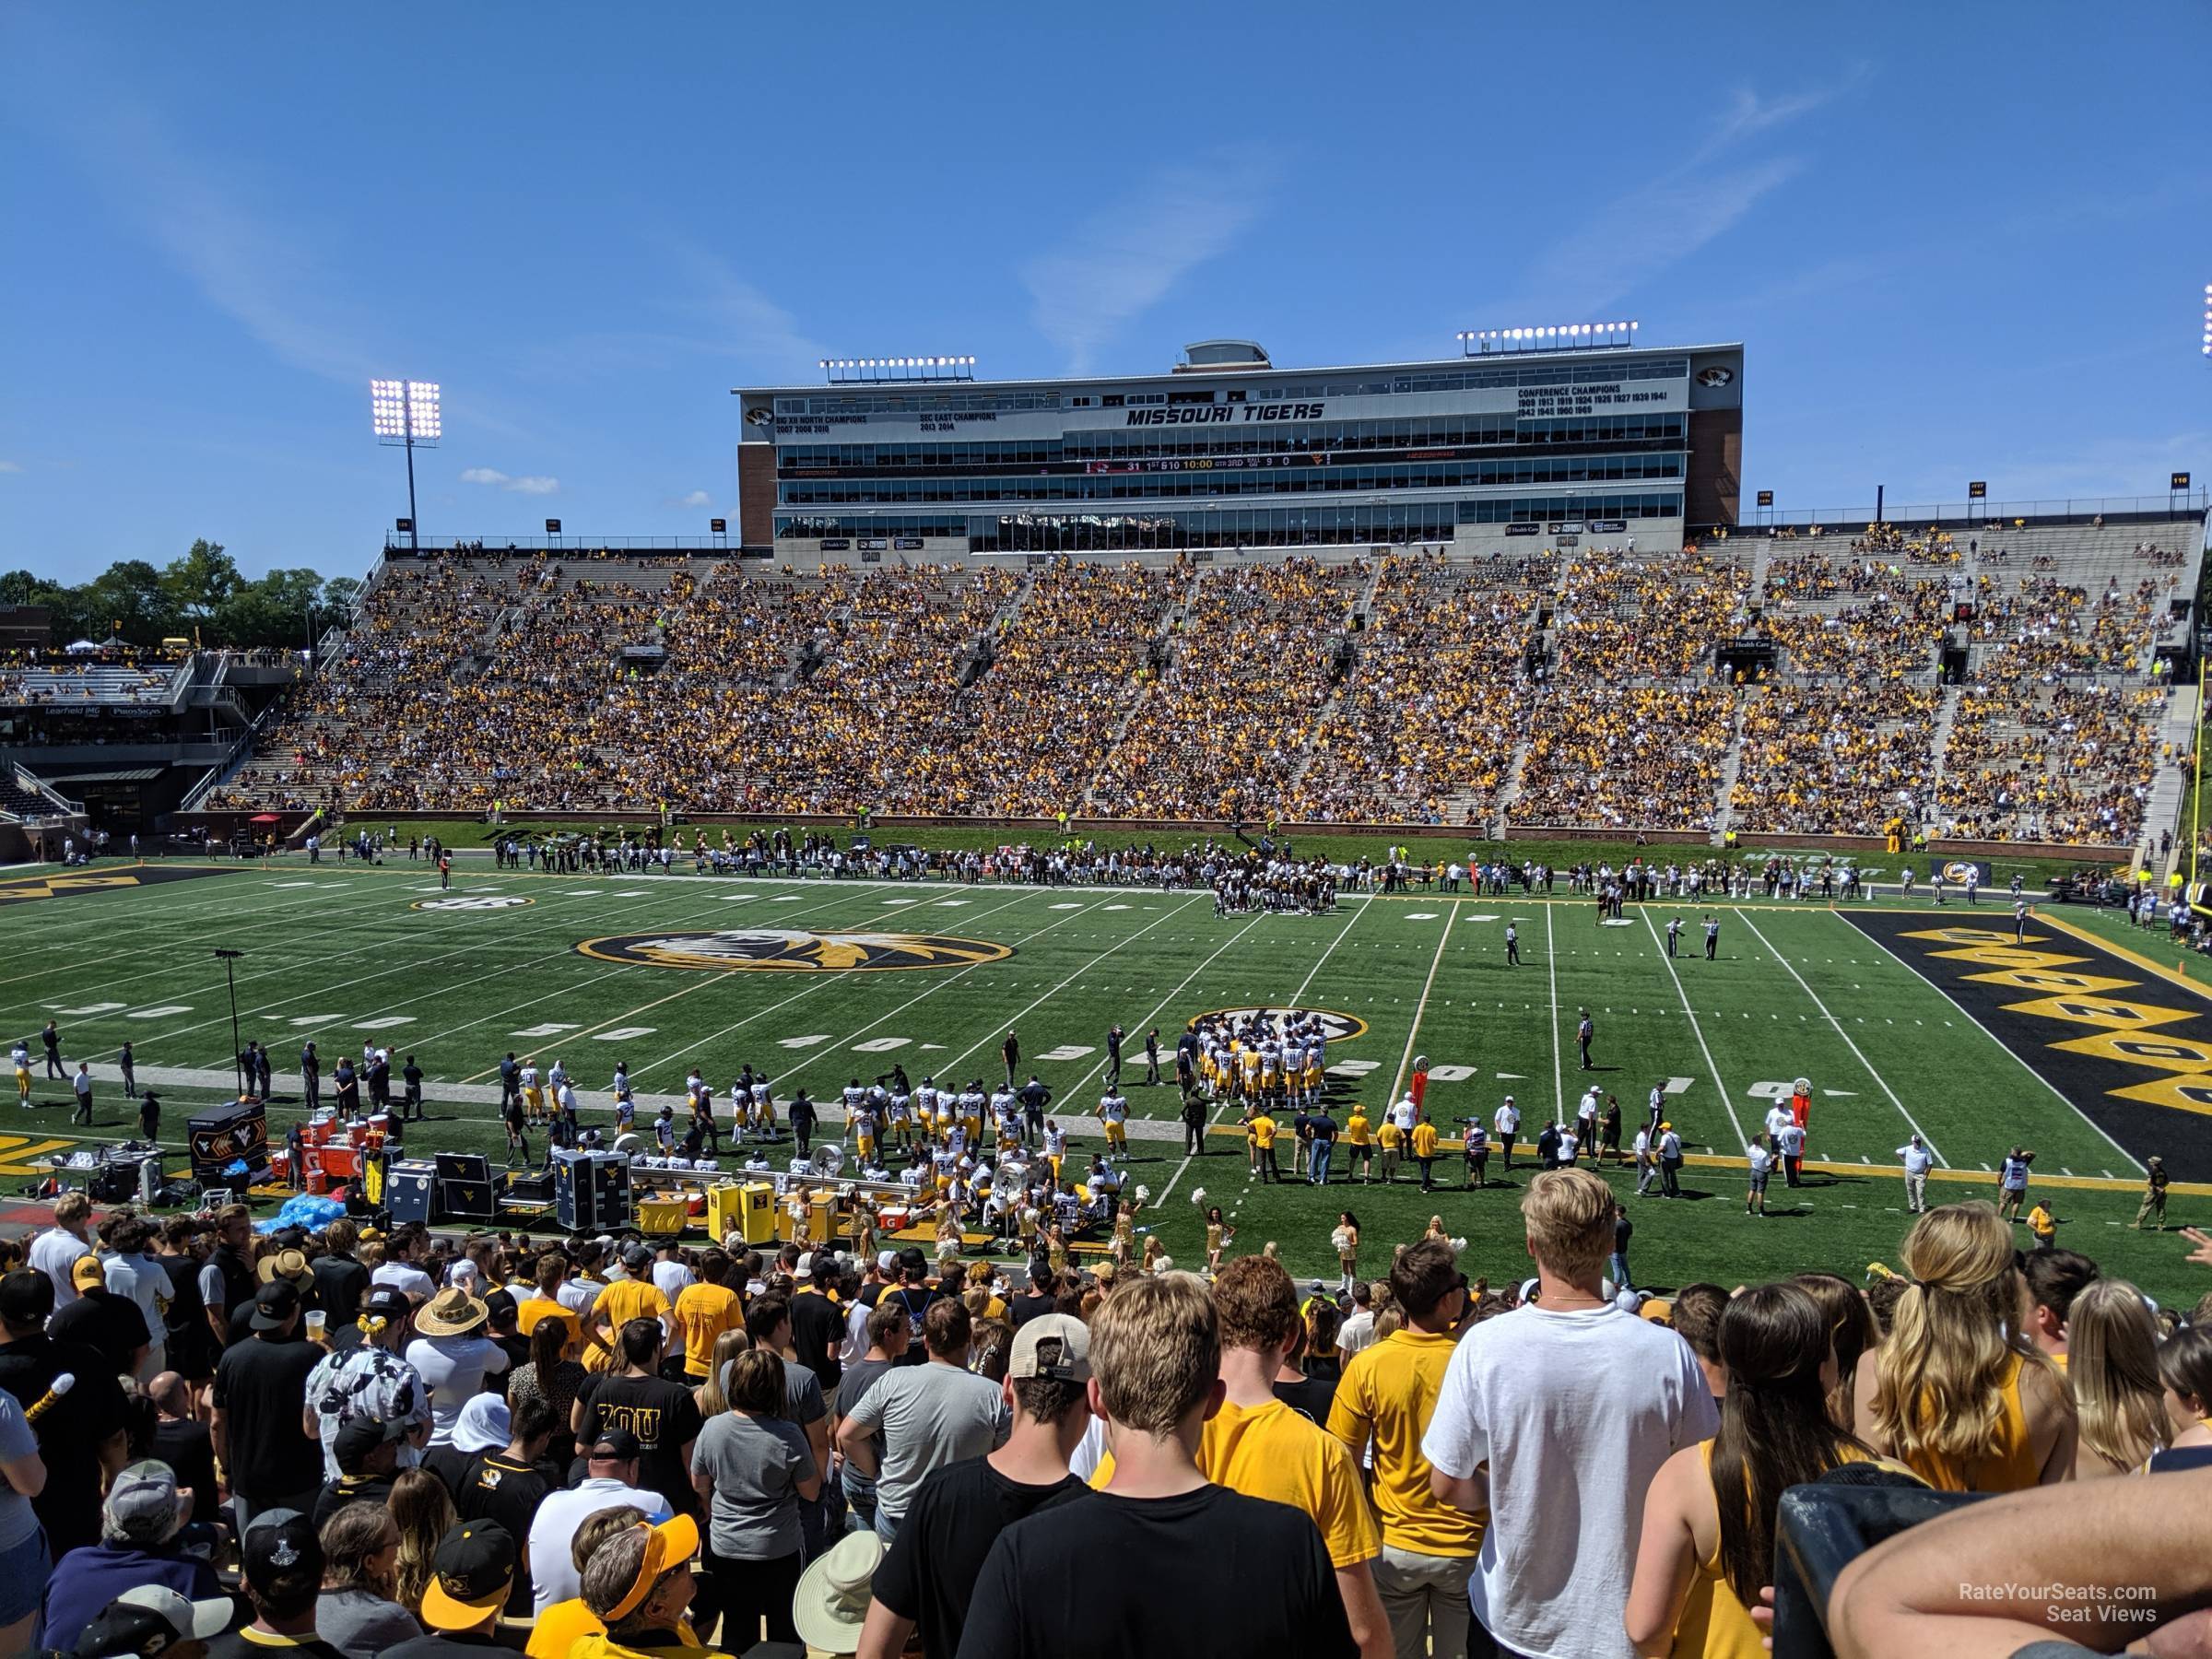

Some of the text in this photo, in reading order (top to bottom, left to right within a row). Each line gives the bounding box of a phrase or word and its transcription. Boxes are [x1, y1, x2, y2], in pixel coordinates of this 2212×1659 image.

[1518, 384, 1620, 398] CONFERENCE CHAMPIONS
[1518, 398, 1535, 407] 1909
[1614, 394, 1630, 403] 1927
[1651, 392, 1667, 401] 1941
[800, 416, 823, 424] NORTH
[824, 415, 867, 424] CHAMPIONS
[920, 412, 996, 422] SEC EAST CHAMPIONS
[1126, 403, 1325, 426] MISSOURI TIGERS
[776, 425, 793, 434] 2007
[920, 422, 955, 431] 2013 2014
[1127, 462, 1140, 471] 31
[1183, 460, 1213, 469] 10:00
[1227, 459, 1243, 467] 3RD
[1282, 456, 1290, 465] 0
[45, 706, 101, 715] Learfield IMG
[304, 1151, 321, 1171] G
[938, 1159, 955, 1171] 34
[886, 1218, 896, 1228] G
